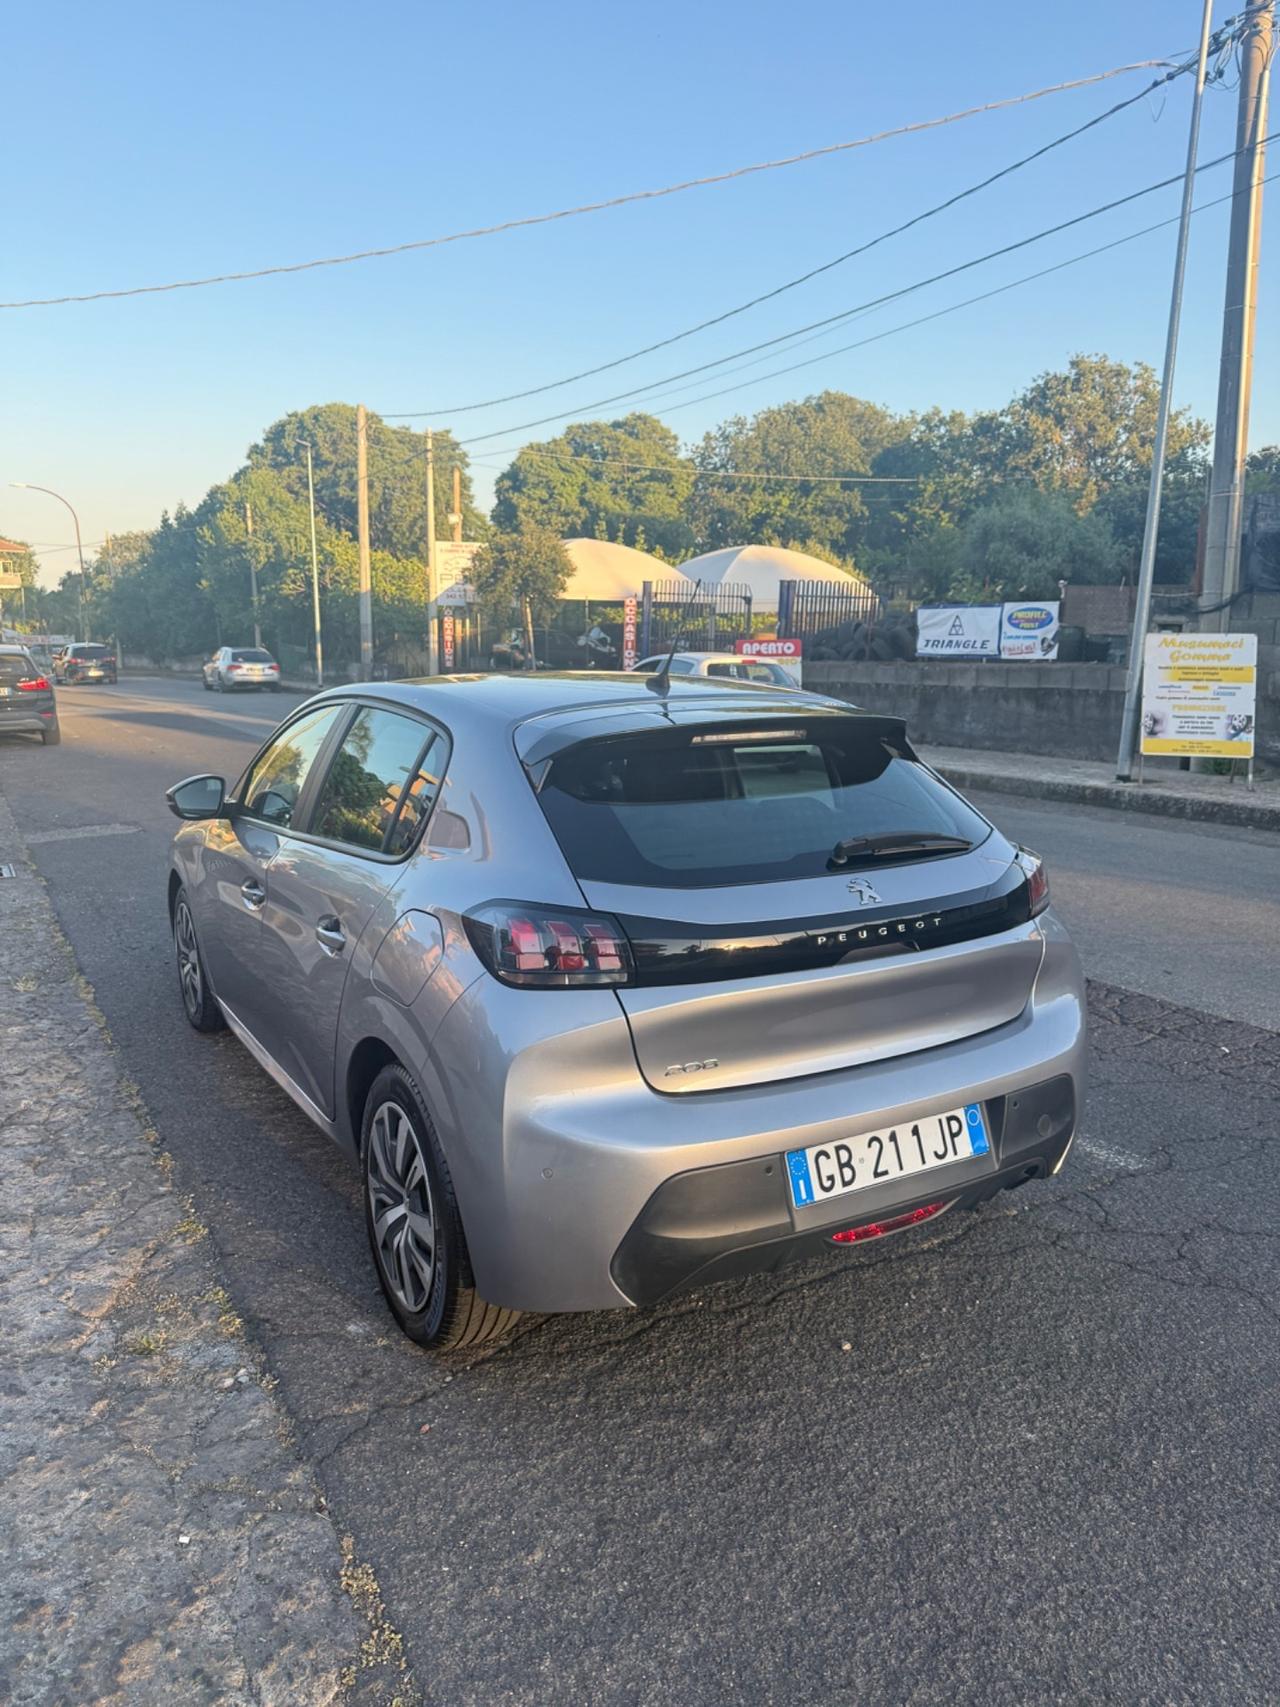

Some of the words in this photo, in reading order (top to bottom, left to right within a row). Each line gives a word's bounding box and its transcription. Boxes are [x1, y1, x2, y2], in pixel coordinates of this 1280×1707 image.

[742, 642, 795, 655] APERTO
[923, 639, 990, 650] TRIANGLE
[817, 917, 943, 946] PEUGEOT
[814, 1143, 857, 1193] GB
